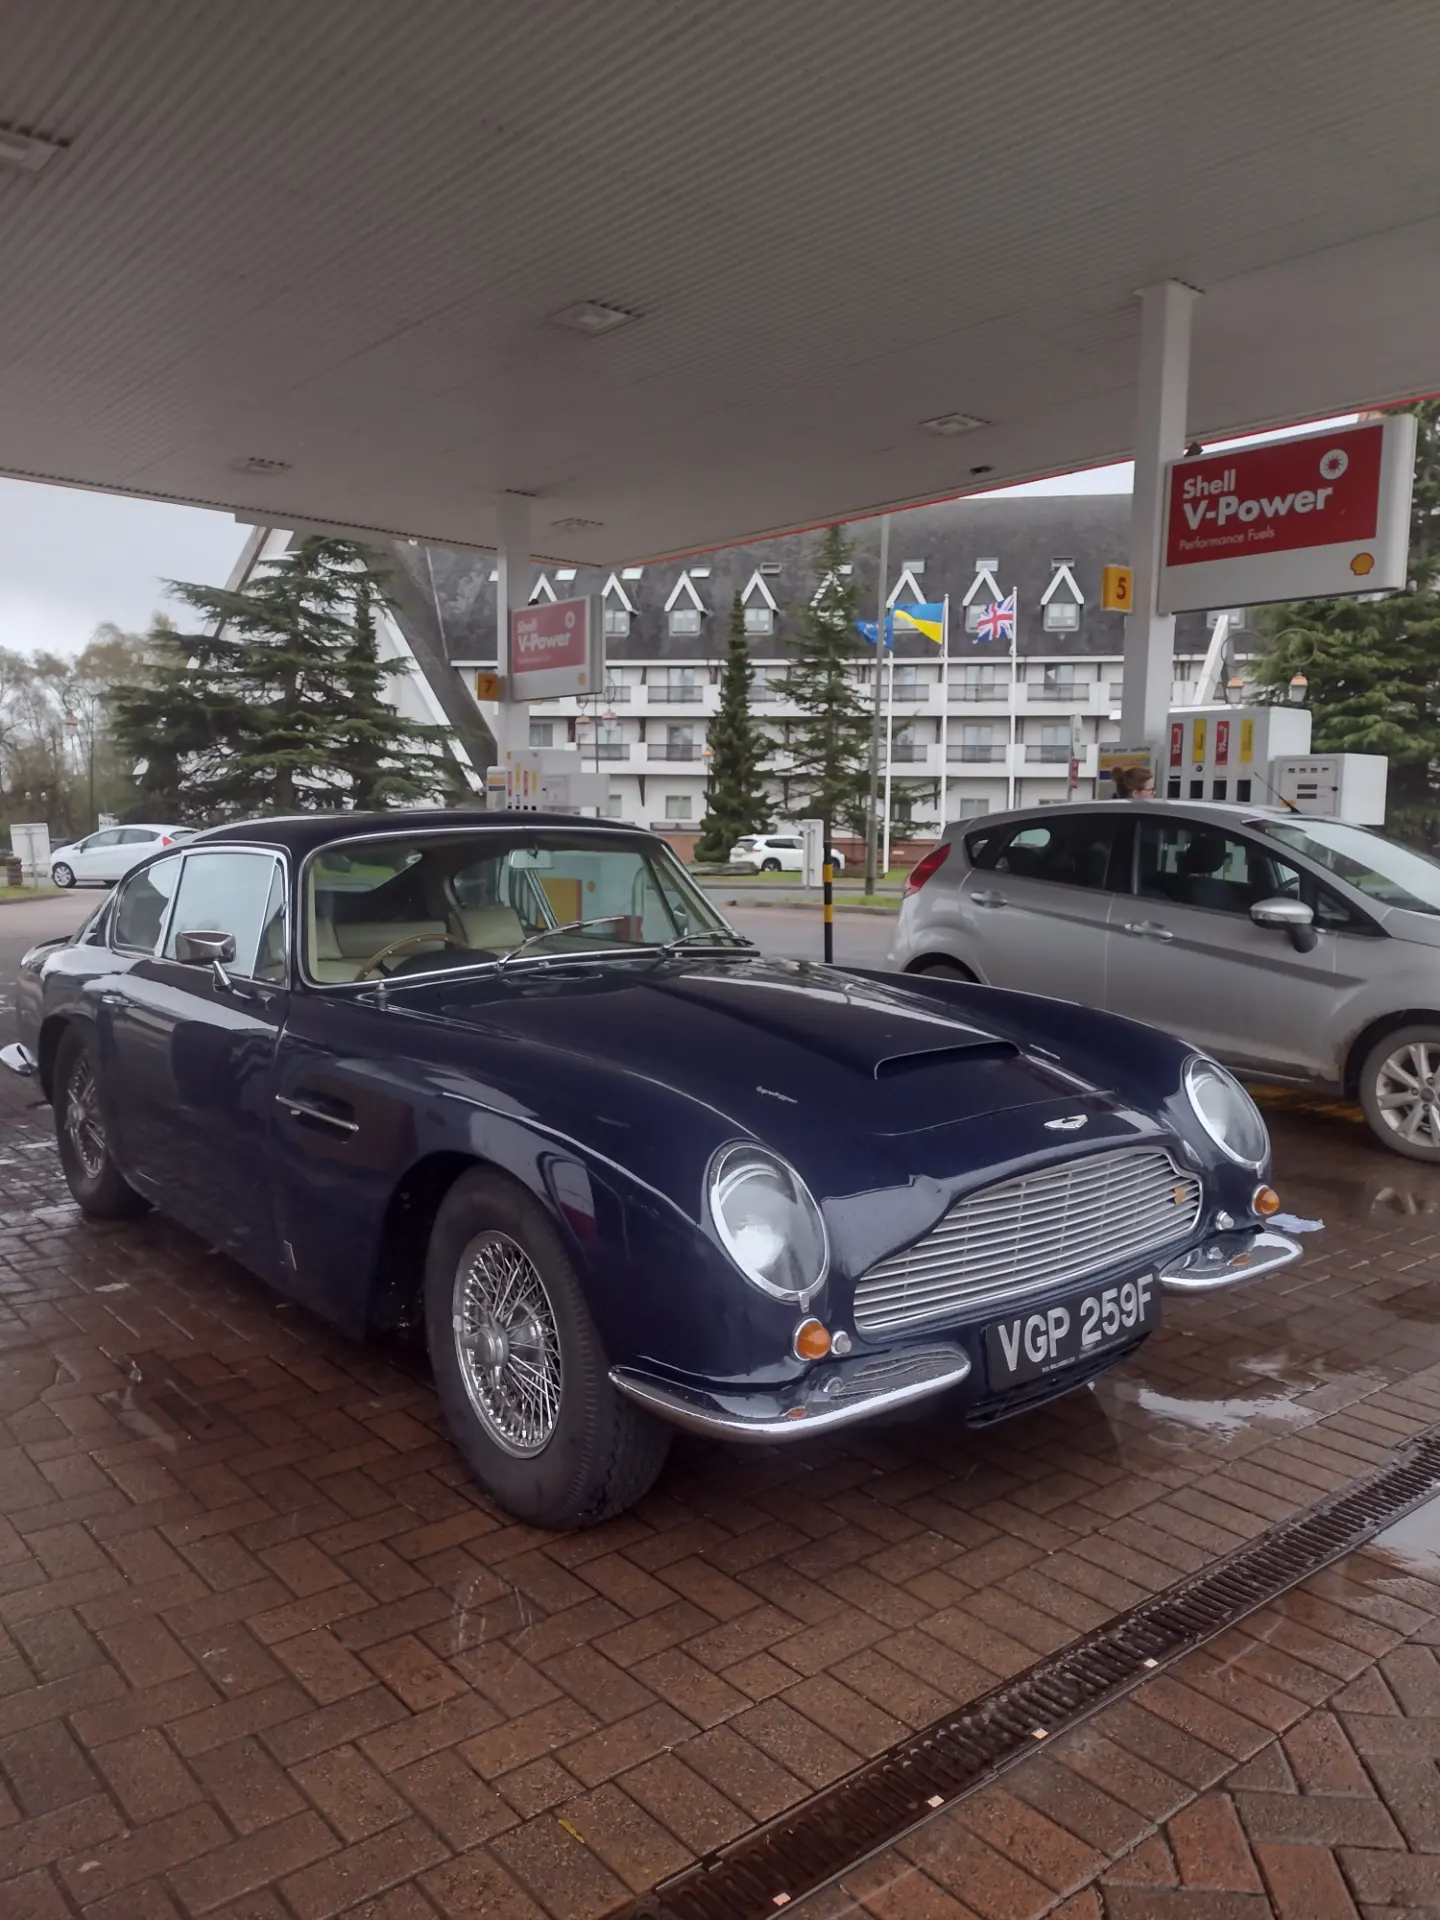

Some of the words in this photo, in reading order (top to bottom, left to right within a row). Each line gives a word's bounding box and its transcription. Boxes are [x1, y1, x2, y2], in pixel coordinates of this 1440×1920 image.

[1183, 468, 1236, 499] Shell
[1183, 487, 1333, 531] V-Power
[1179, 533, 1244, 551] Performance
[1248, 525, 1275, 541] Fuels
[1116, 576, 1127, 600] 5
[517, 618, 537, 634] Shell
[517, 632, 571, 653] V-Power
[484, 680, 493, 694] 7
[998, 1307, 1071, 1372] VGP
[1080, 1273, 1153, 1346] 259F
